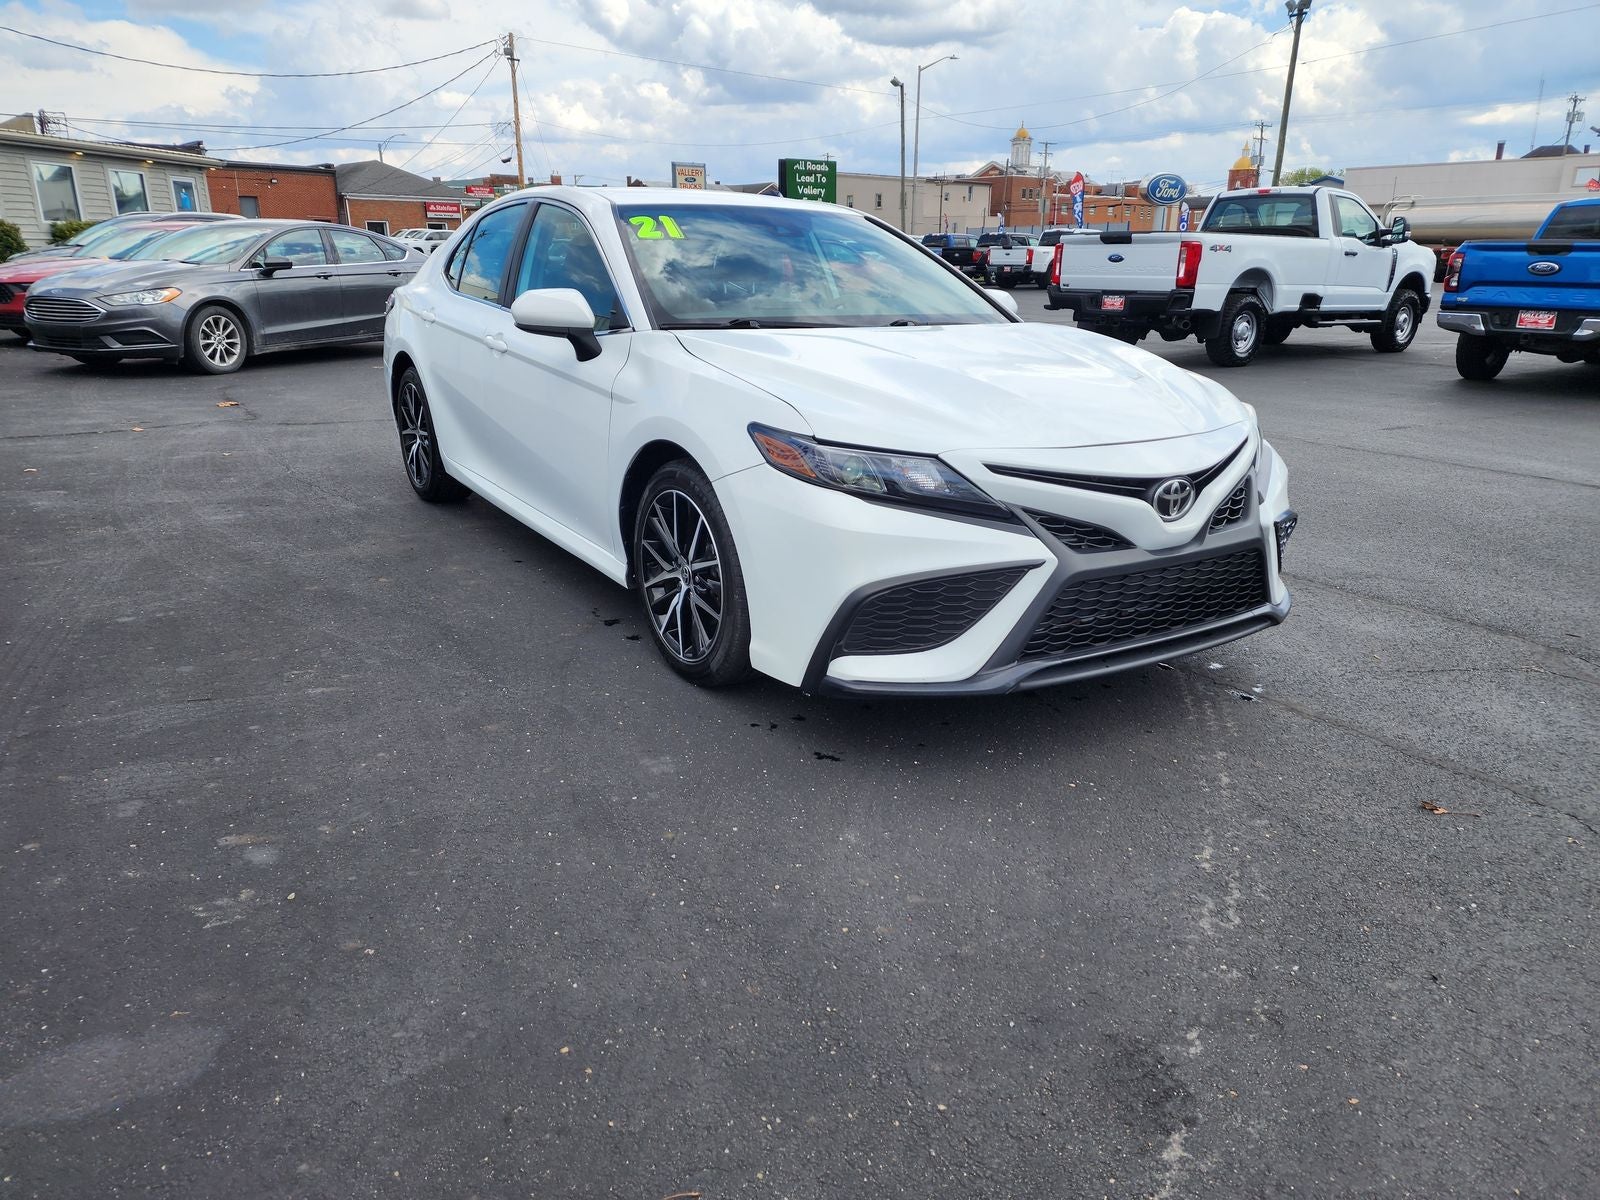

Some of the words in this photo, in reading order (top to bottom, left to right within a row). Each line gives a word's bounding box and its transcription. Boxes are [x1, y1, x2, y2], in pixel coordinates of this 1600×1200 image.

[793, 161, 806, 170] All
[806, 161, 829, 171] Roads
[676, 168, 704, 177] VALLERY
[796, 173, 815, 182] Lead
[816, 173, 827, 183] To
[797, 185, 826, 197] Vallery
[1155, 178, 1181, 199] Ford
[629, 215, 685, 239] 21
